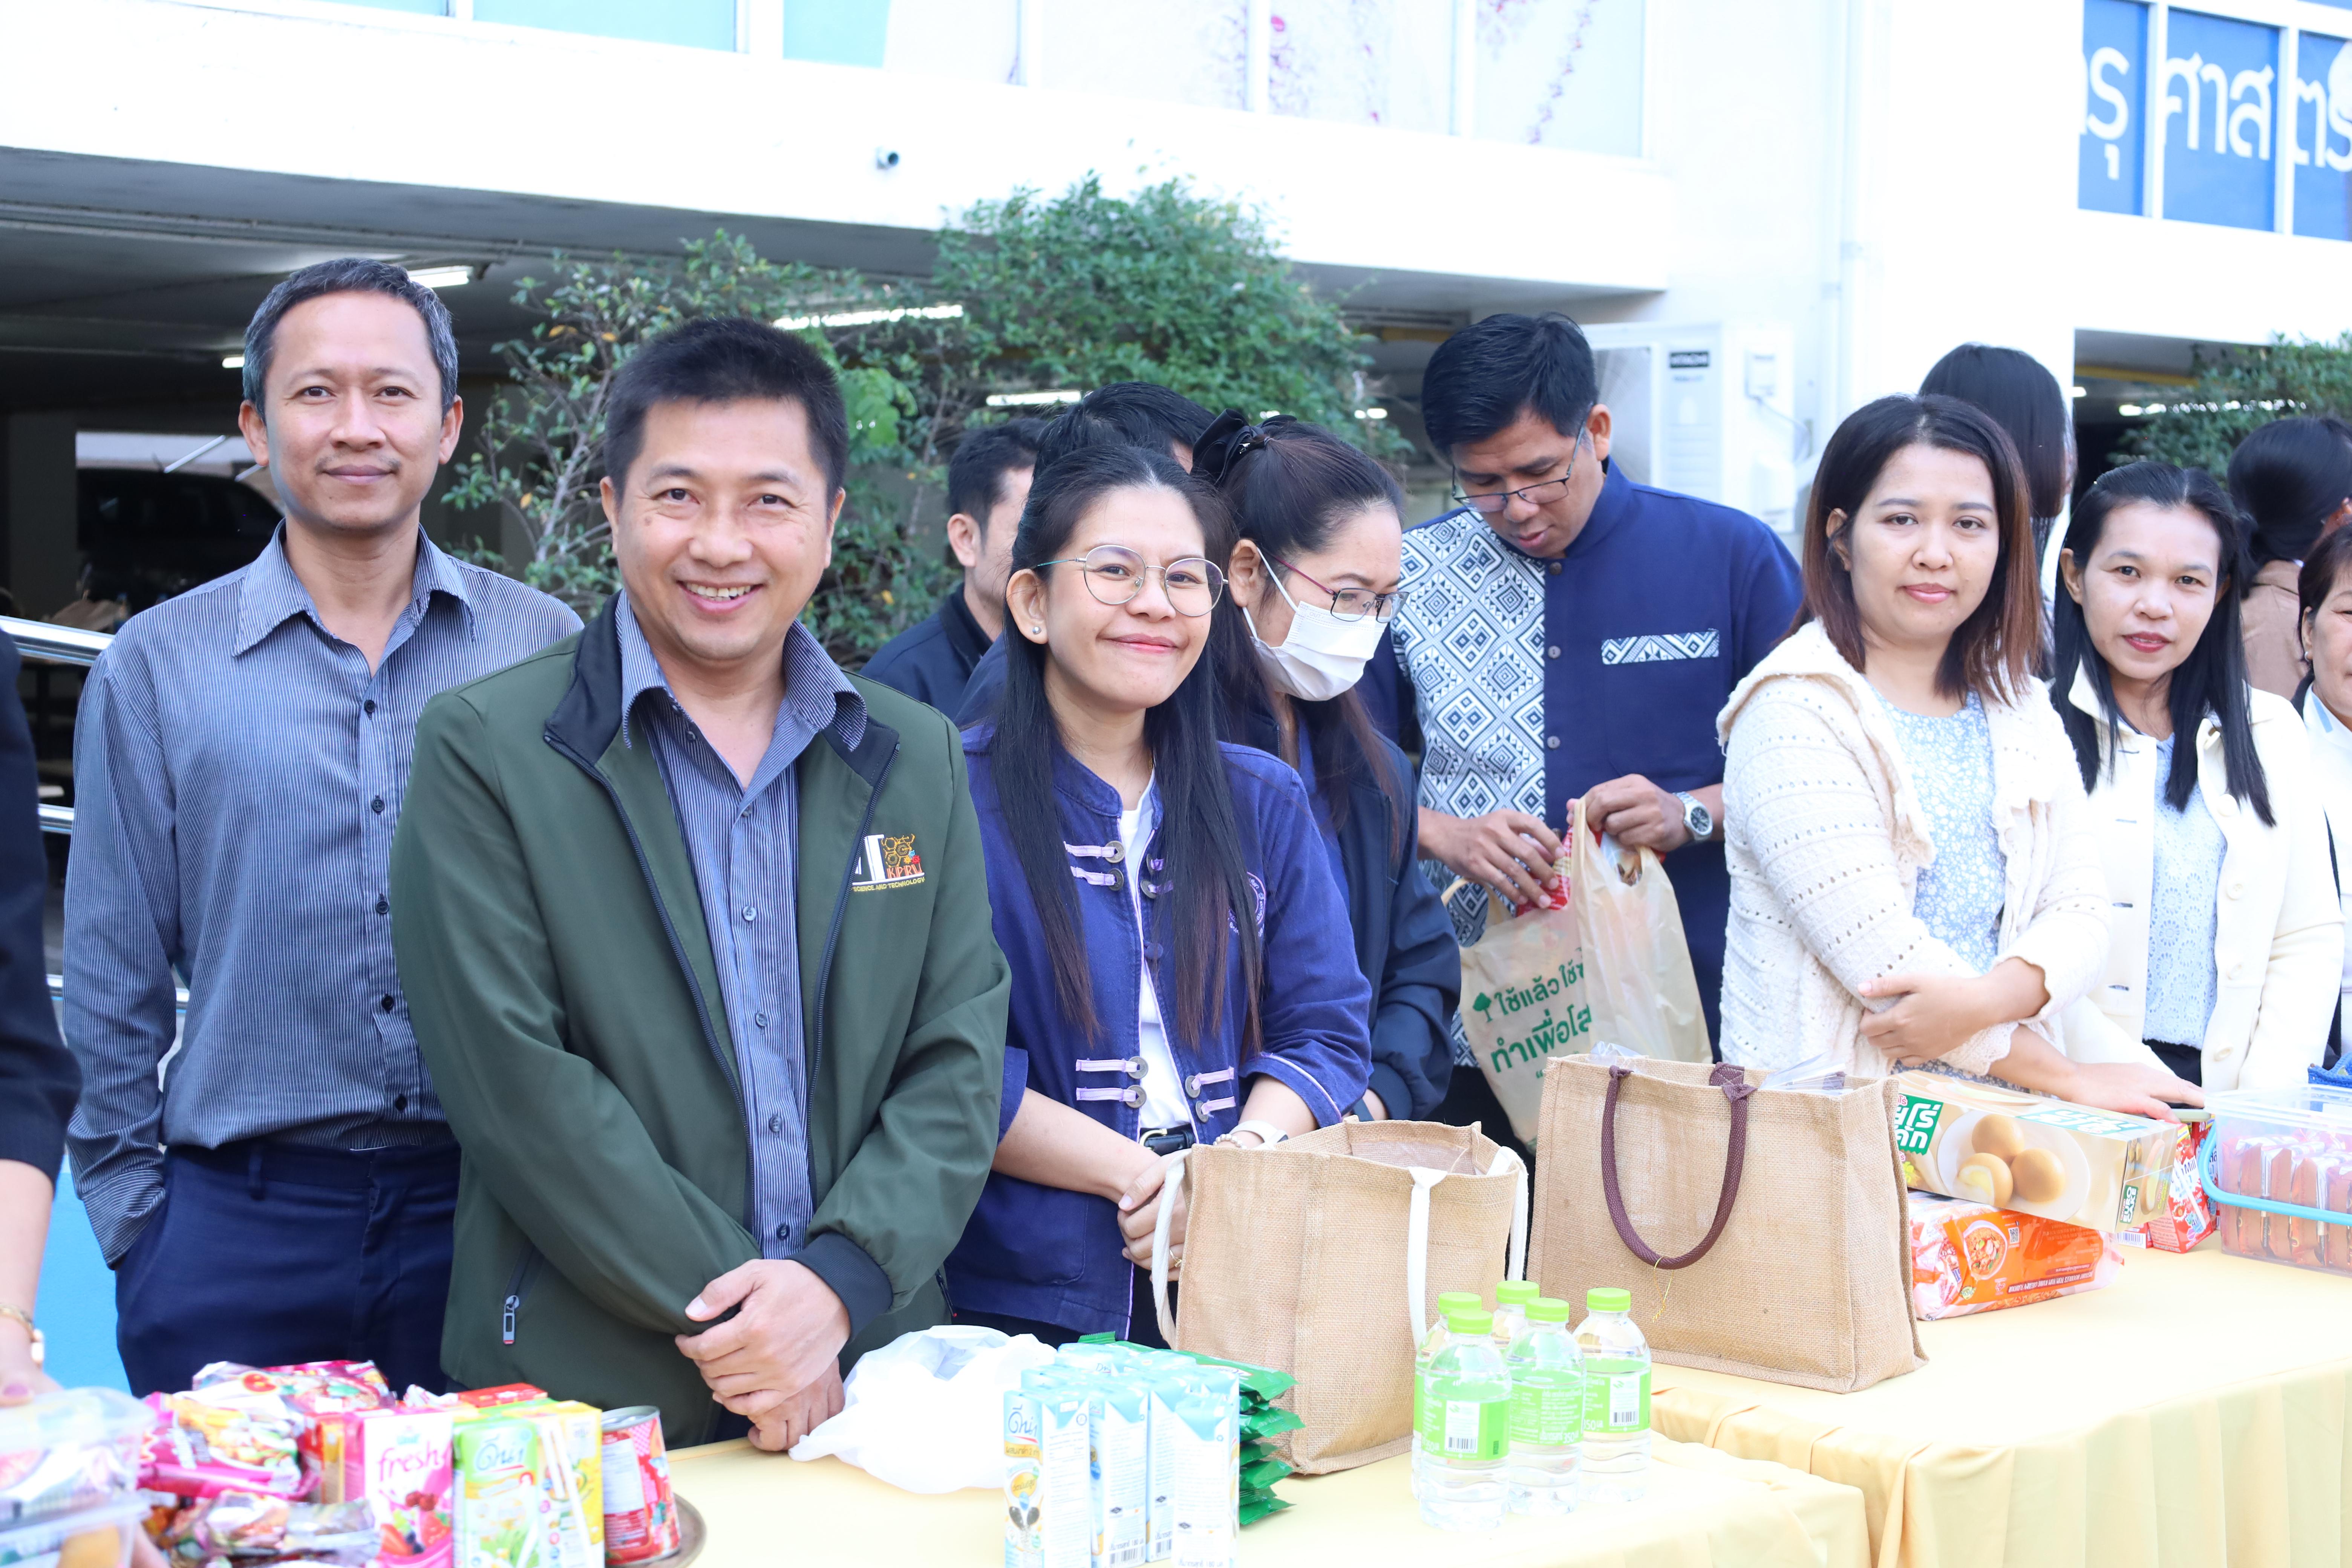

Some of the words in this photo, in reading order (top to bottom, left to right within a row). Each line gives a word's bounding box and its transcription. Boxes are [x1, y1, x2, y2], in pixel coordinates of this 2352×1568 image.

[887, 876, 925, 889] TECHNOLOGY
[2123, 1186, 2132, 1222] EURO
[2127, 1188, 2137, 1222] CAKE
[378, 1441, 440, 1482] fresh
